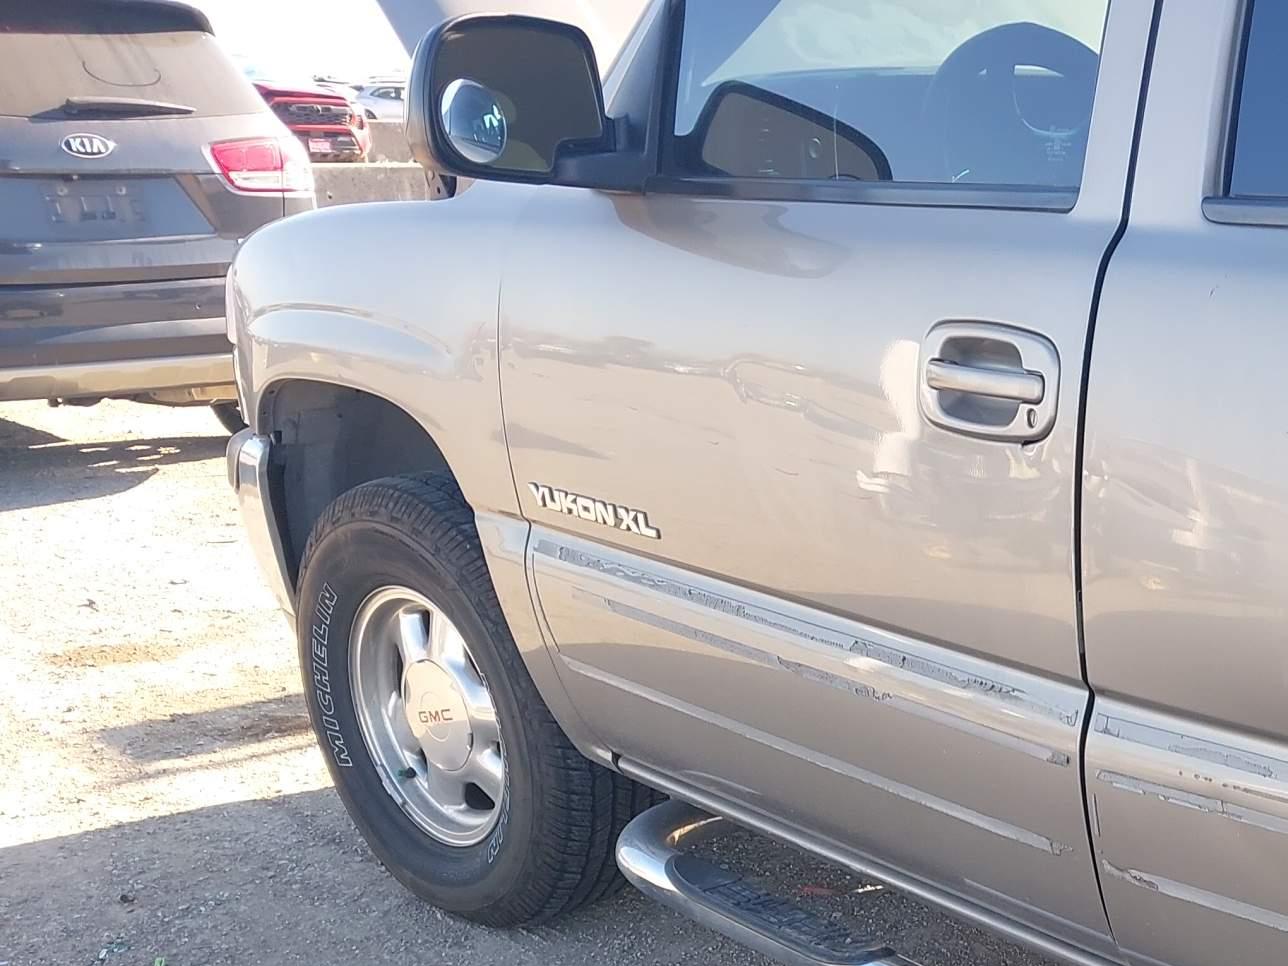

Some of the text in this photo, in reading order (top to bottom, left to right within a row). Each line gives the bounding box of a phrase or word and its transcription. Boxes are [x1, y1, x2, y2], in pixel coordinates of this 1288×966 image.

[68, 137, 107, 153] KIA
[528, 482, 662, 540] YUKON XL
[311, 582, 353, 767] MICHELIN
[418, 708, 453, 723] GMC
